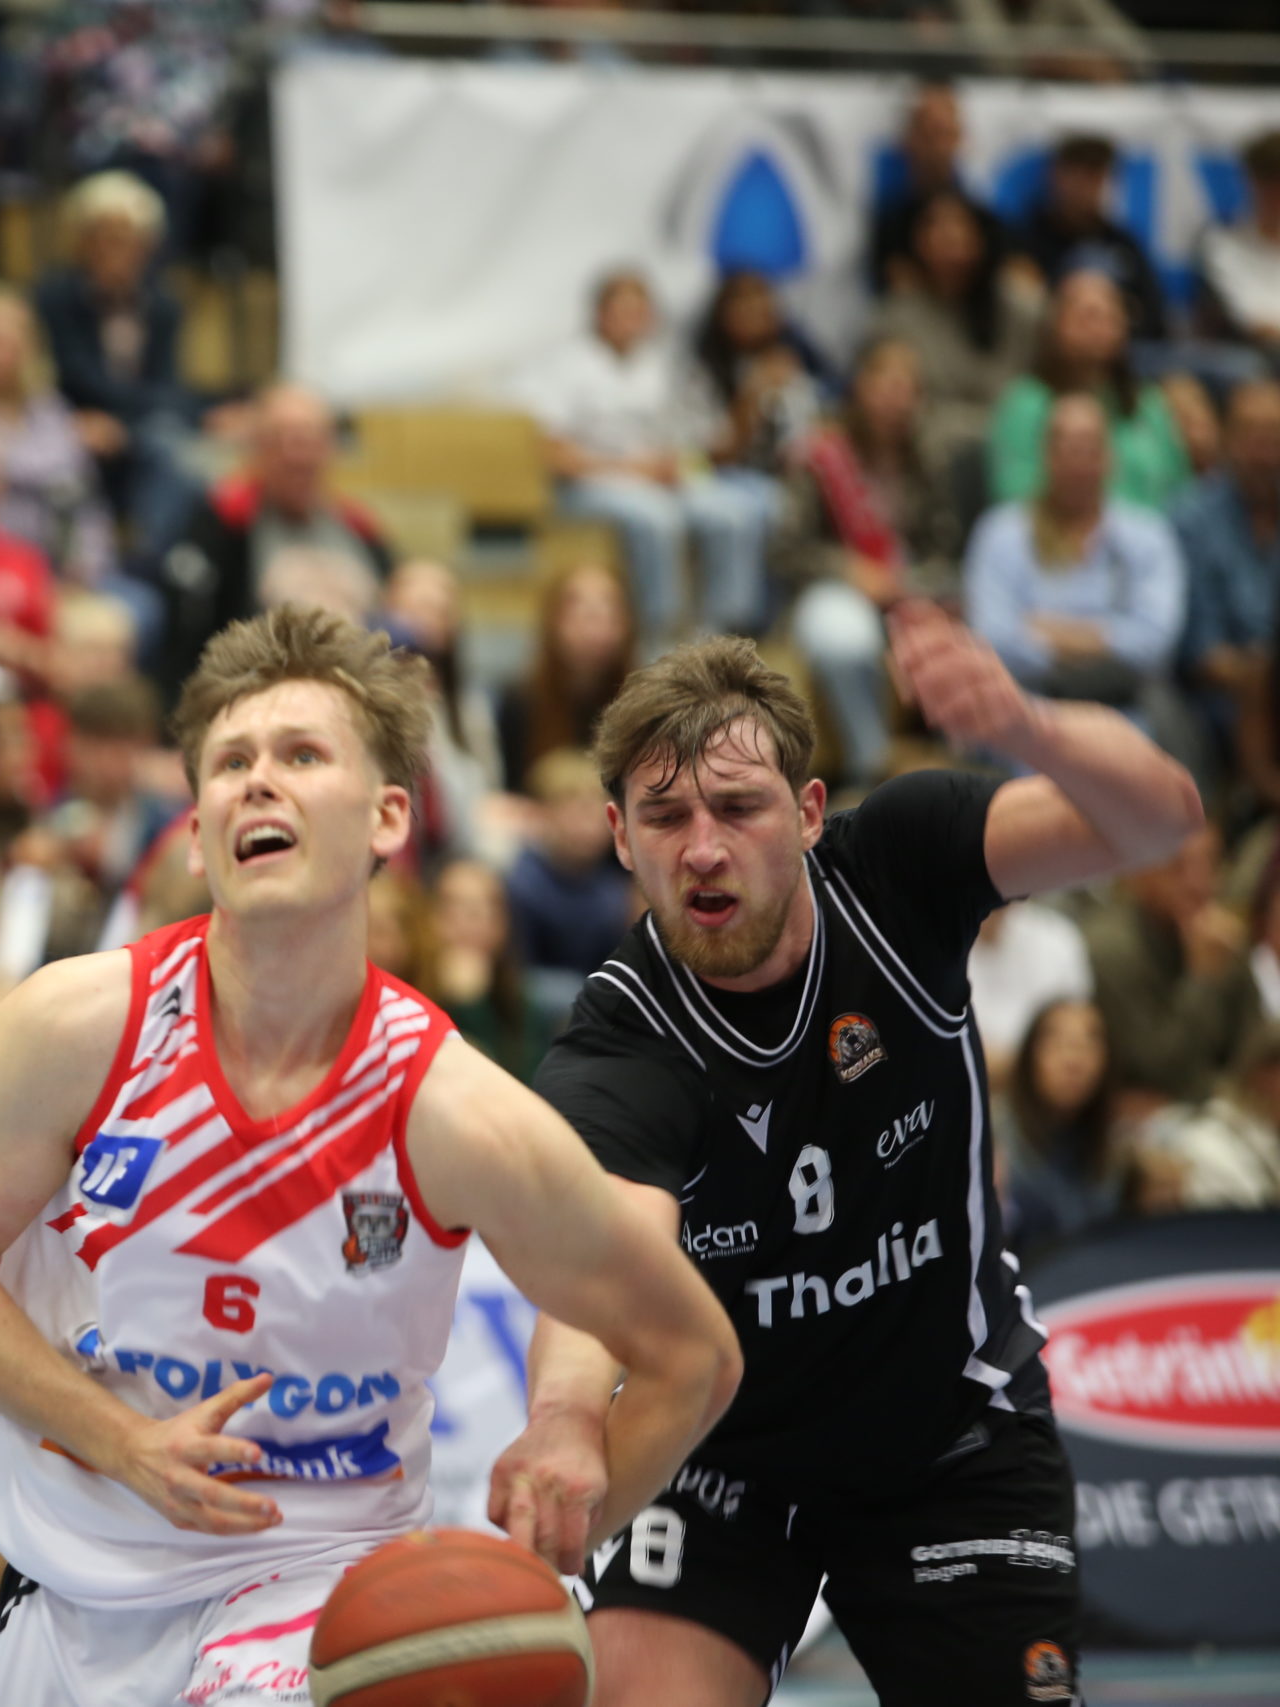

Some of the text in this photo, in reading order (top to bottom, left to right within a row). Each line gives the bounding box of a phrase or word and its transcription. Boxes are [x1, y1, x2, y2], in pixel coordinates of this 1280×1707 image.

[876, 1099, 935, 1158] eva
[788, 1143, 835, 1235] 8
[681, 1220, 759, 1254] Adam
[203, 1273, 261, 1335] 6
[744, 1217, 945, 1329] Thalia
[629, 1505, 687, 1589] 8
[913, 1562, 978, 1584] Hagen
